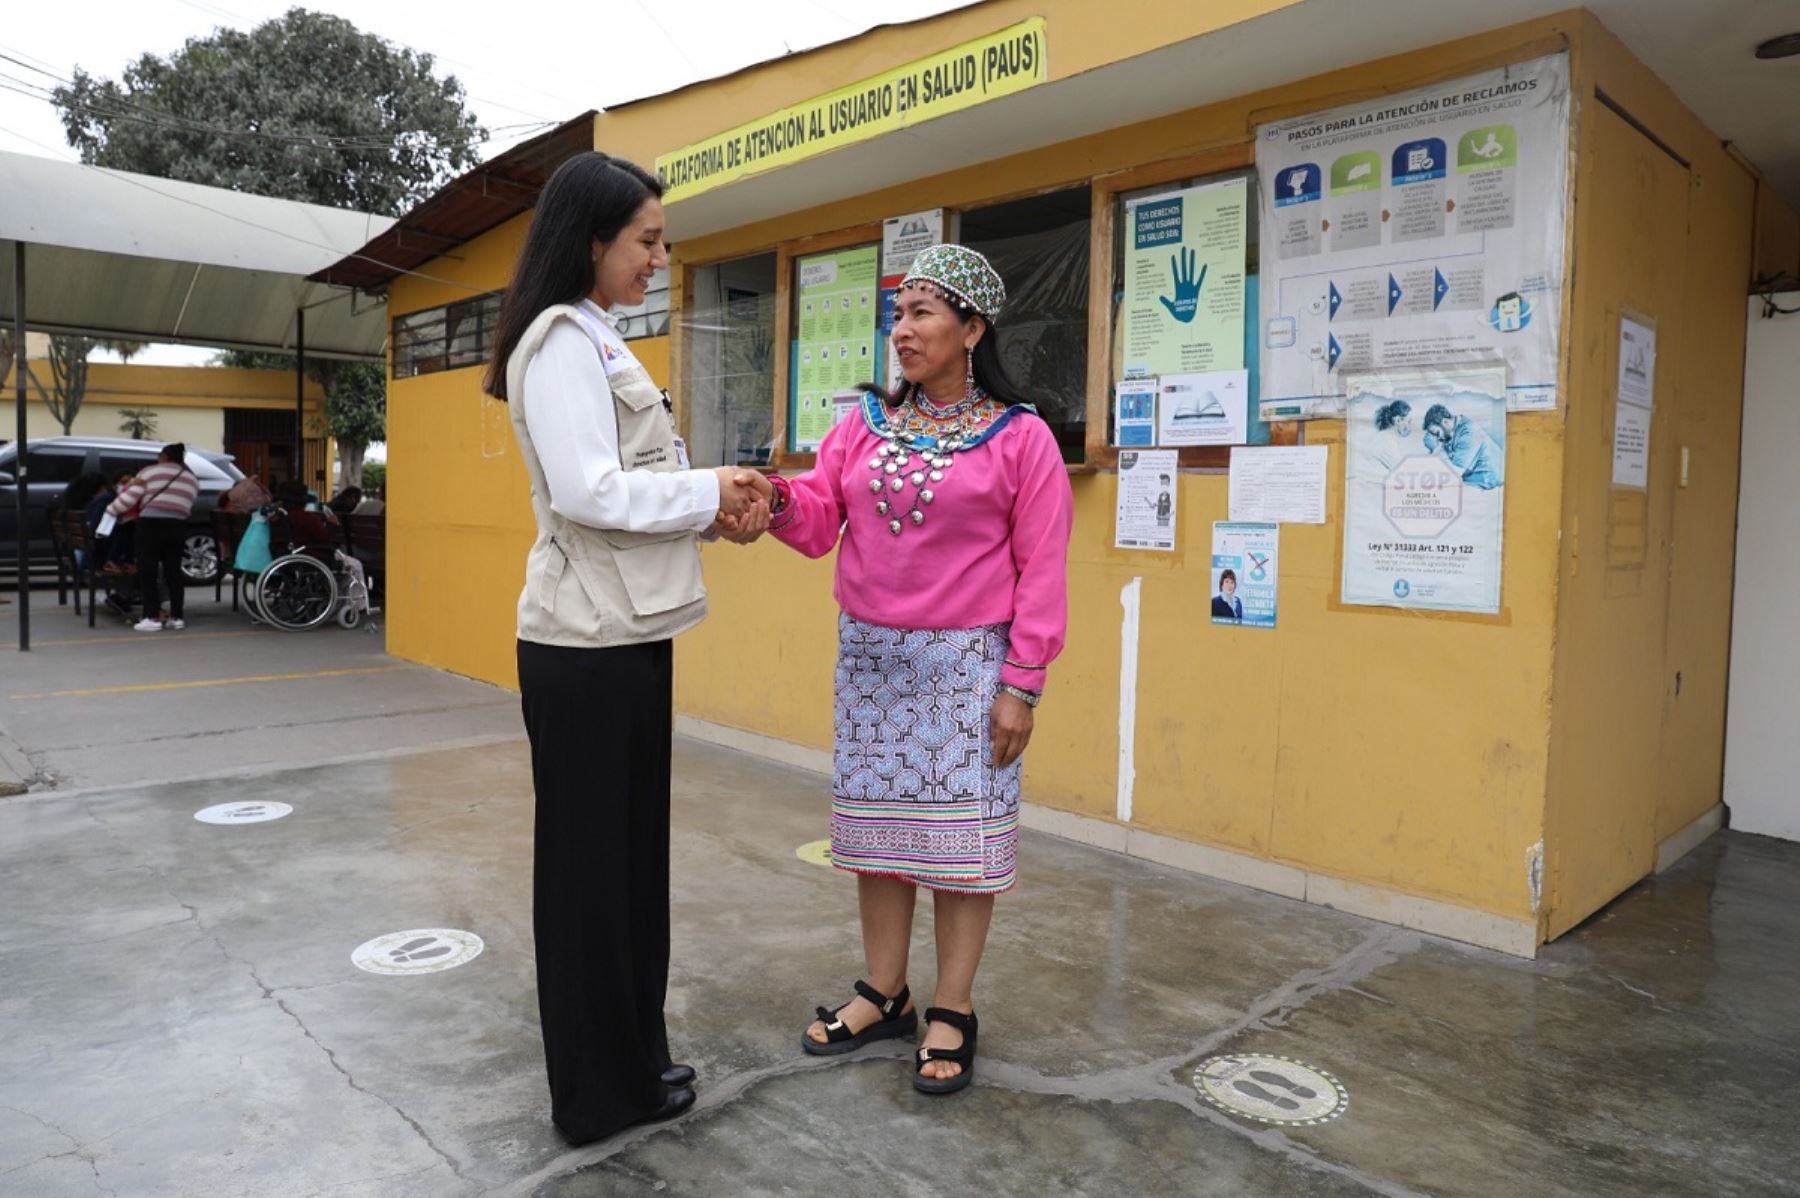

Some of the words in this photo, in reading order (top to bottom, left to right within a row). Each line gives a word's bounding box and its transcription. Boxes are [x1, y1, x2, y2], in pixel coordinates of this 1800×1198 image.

[658, 146, 724, 188] PLATAFORMA
[727, 140, 741, 169] DE
[744, 113, 805, 163] ATENCIÓN
[808, 111, 825, 141] AL
[830, 84, 892, 134] USUARIO
[897, 74, 917, 112] EN
[923, 55, 975, 99] SALUD
[982, 31, 1040, 93] (PAUS)
[1288, 125, 1323, 142] PASOS
[1325, 117, 1356, 133] PARA
[1360, 114, 1373, 125] LA
[1376, 100, 1439, 121] ATENCIÓN
[1442, 95, 1460, 107] DE
[1463, 79, 1537, 103] RECLAMOS
[1393, 471, 1450, 490] STOP
[1368, 542, 1381, 552] Ley
[1418, 544, 1434, 552] Art.
[1451, 547, 1458, 555] y
[1459, 545, 1474, 554] 122
